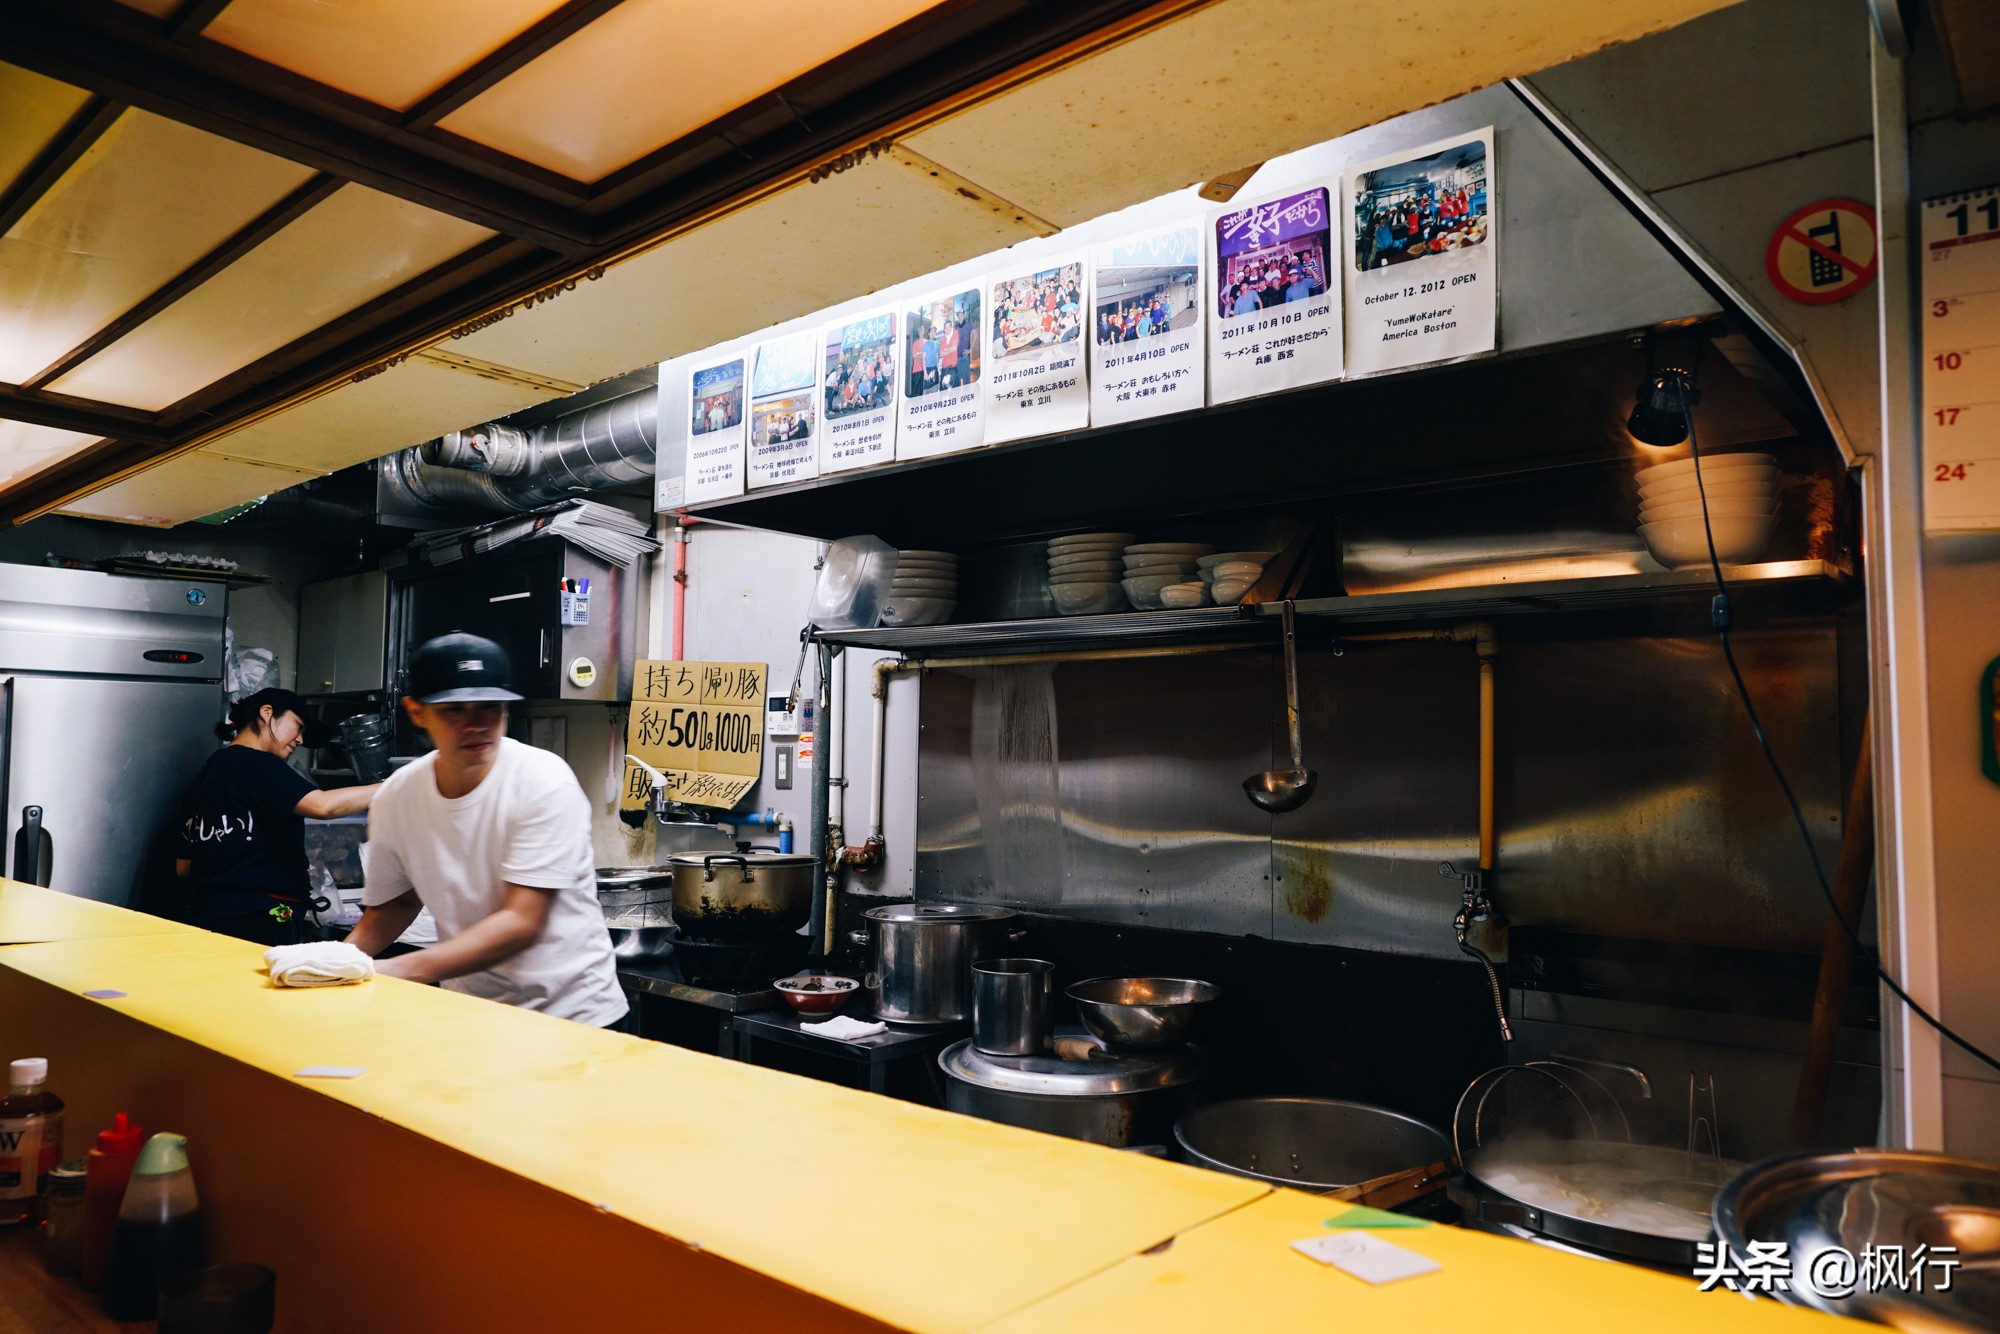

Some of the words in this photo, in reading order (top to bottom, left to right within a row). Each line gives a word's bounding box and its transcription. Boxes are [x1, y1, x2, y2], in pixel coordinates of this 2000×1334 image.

[1946, 198, 1998, 235] 11
[1365, 291, 1399, 305] October
[1421, 280, 1445, 294] 2012
[1451, 273, 1476, 286] OPEN
[1308, 305, 1329, 318] OPEN
[1932, 300, 1949, 318] 3
[1382, 329, 1418, 341] America
[1424, 321, 1457, 334] Boston
[1105, 348, 1165, 368] 2011年4月10日
[1170, 342, 1189, 353] OPEN
[1256, 354, 1271, 365] 兵庫
[1277, 350, 1294, 360] 西宮
[1933, 352, 1962, 371] 10
[993, 365, 1045, 383] 2011年10月2日
[1050, 358, 1076, 371] 期間満了
[1020, 400, 1033, 408] 東京
[1038, 395, 1051, 405] 立川
[1116, 392, 1131, 402] 大阪
[1135, 387, 1157, 398] 大東市
[1162, 383, 1176, 393] 赤井
[910, 398, 957, 415] 2010年9月23日
[961, 393, 974, 402] OPEN
[1934, 408, 1961, 426] 17
[929, 430, 940, 438] 東京
[944, 427, 955, 436] 立川
[796, 440, 808, 448] OPEN
[1935, 464, 1967, 482] 24
[643, 665, 762, 699] 持ち帰り豚
